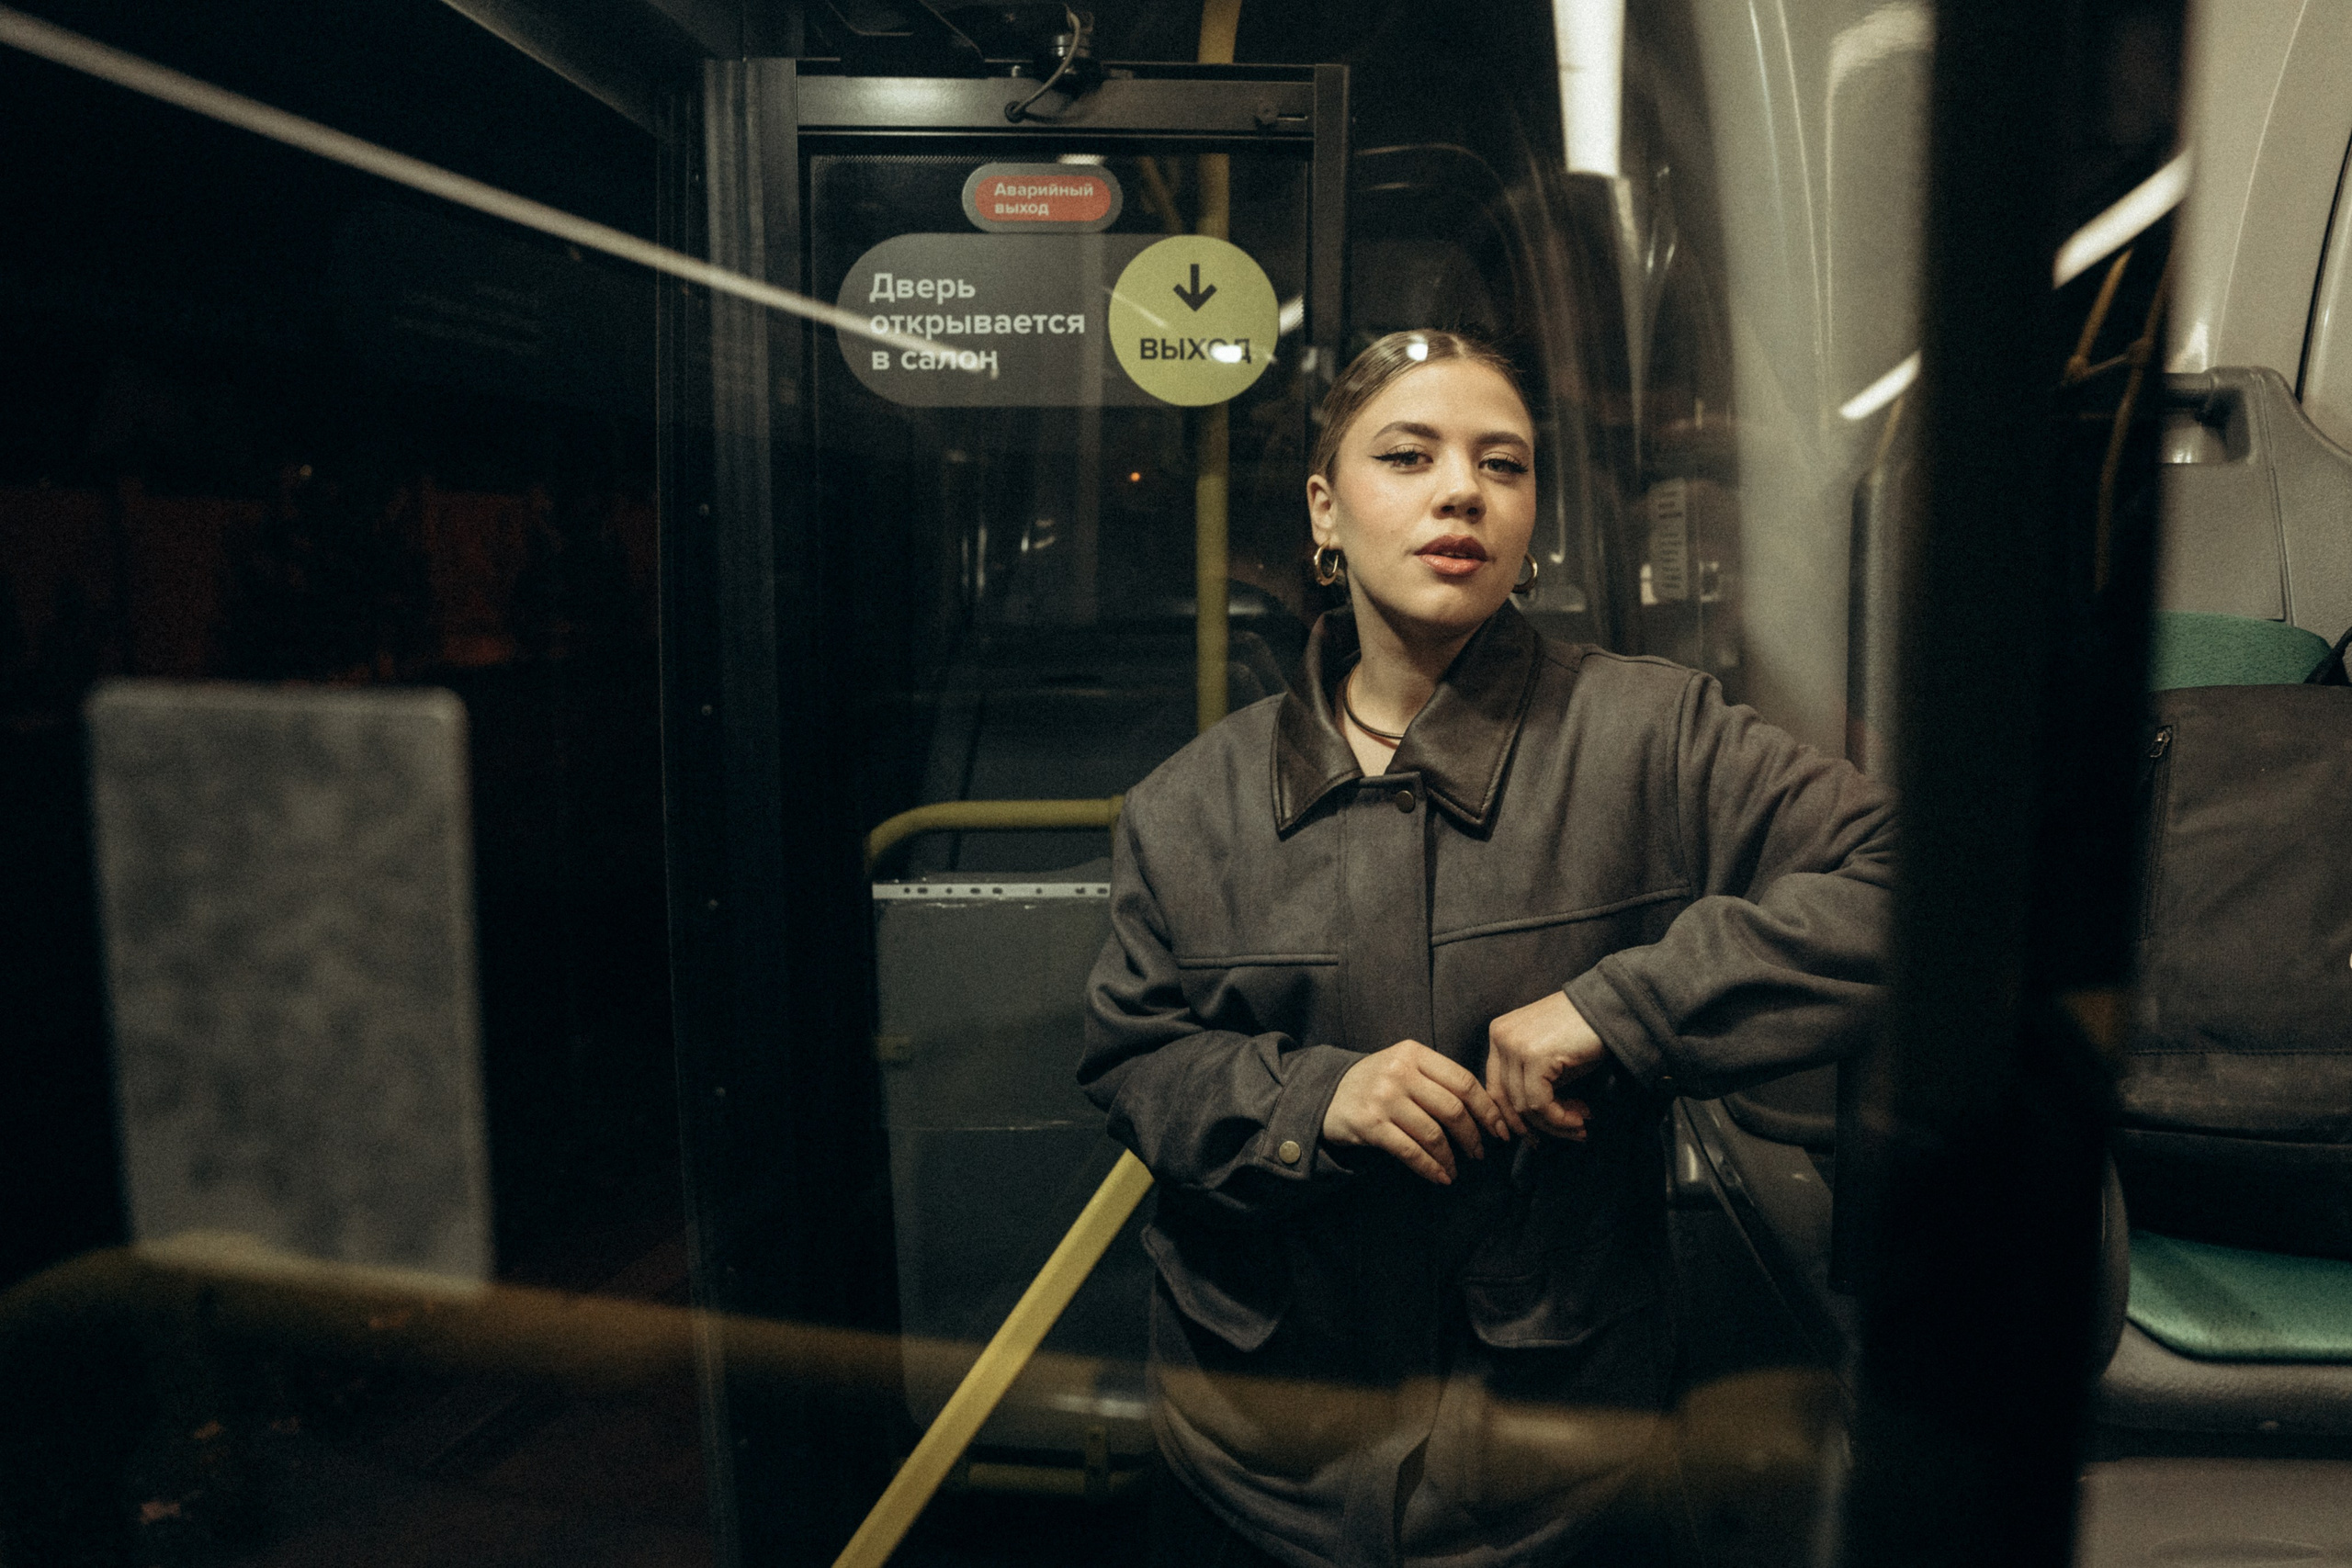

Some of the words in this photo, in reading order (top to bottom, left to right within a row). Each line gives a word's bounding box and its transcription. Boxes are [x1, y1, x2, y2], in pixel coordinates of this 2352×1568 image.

[994, 183, 1093, 199] Аварийный
[995, 203, 1049, 216] выход
[869, 273, 976, 305] Дверь
[871, 314, 1085, 341] открывается
[872, 351, 890, 370] в
[901, 350, 998, 371] салон
